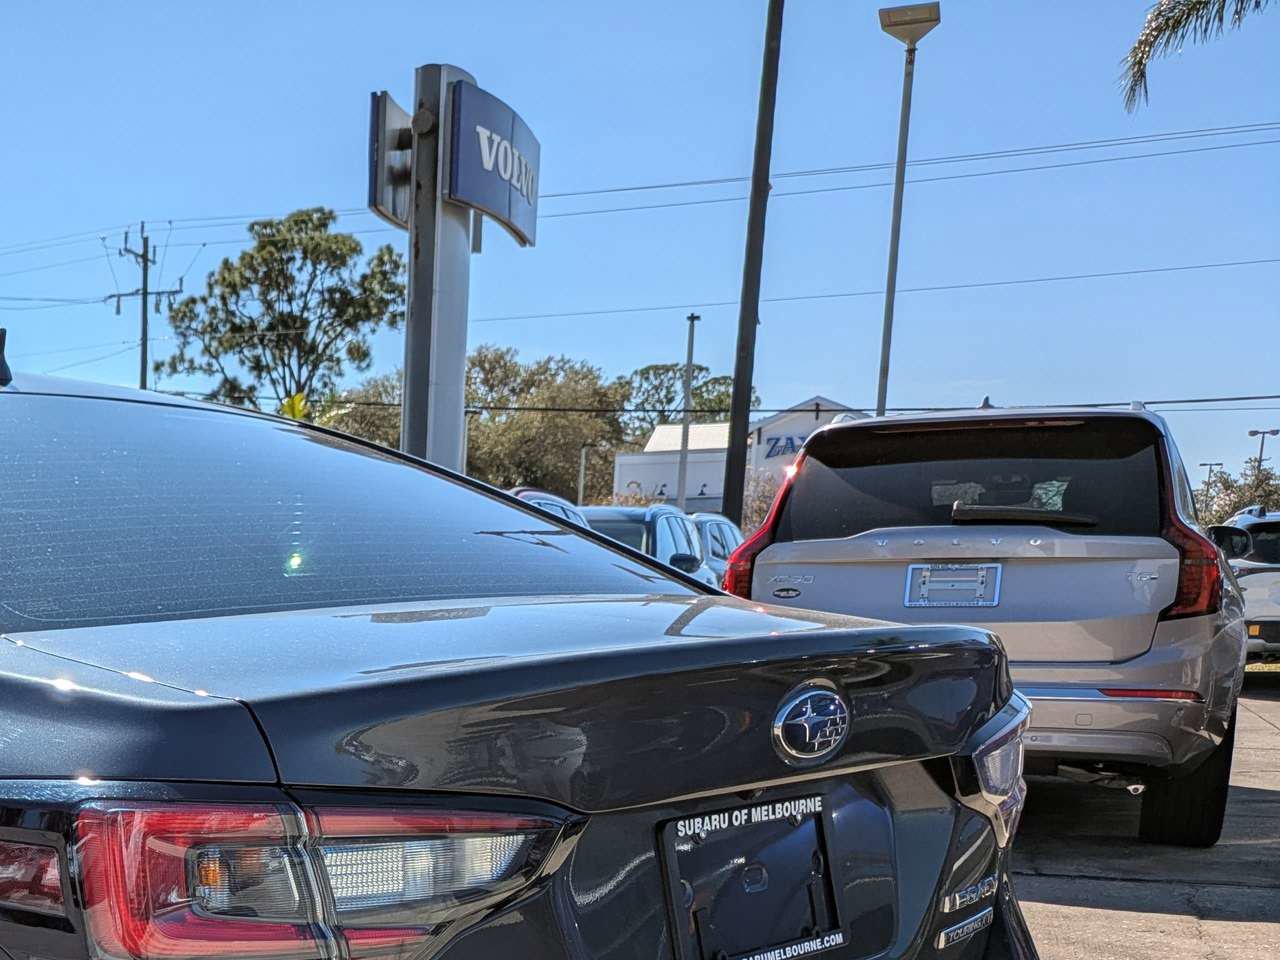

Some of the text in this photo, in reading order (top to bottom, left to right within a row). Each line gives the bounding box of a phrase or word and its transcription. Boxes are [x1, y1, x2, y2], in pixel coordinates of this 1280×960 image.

[476, 126, 535, 205] VOLVO
[677, 797, 822, 837] SUBARU OF MELBOURNE
